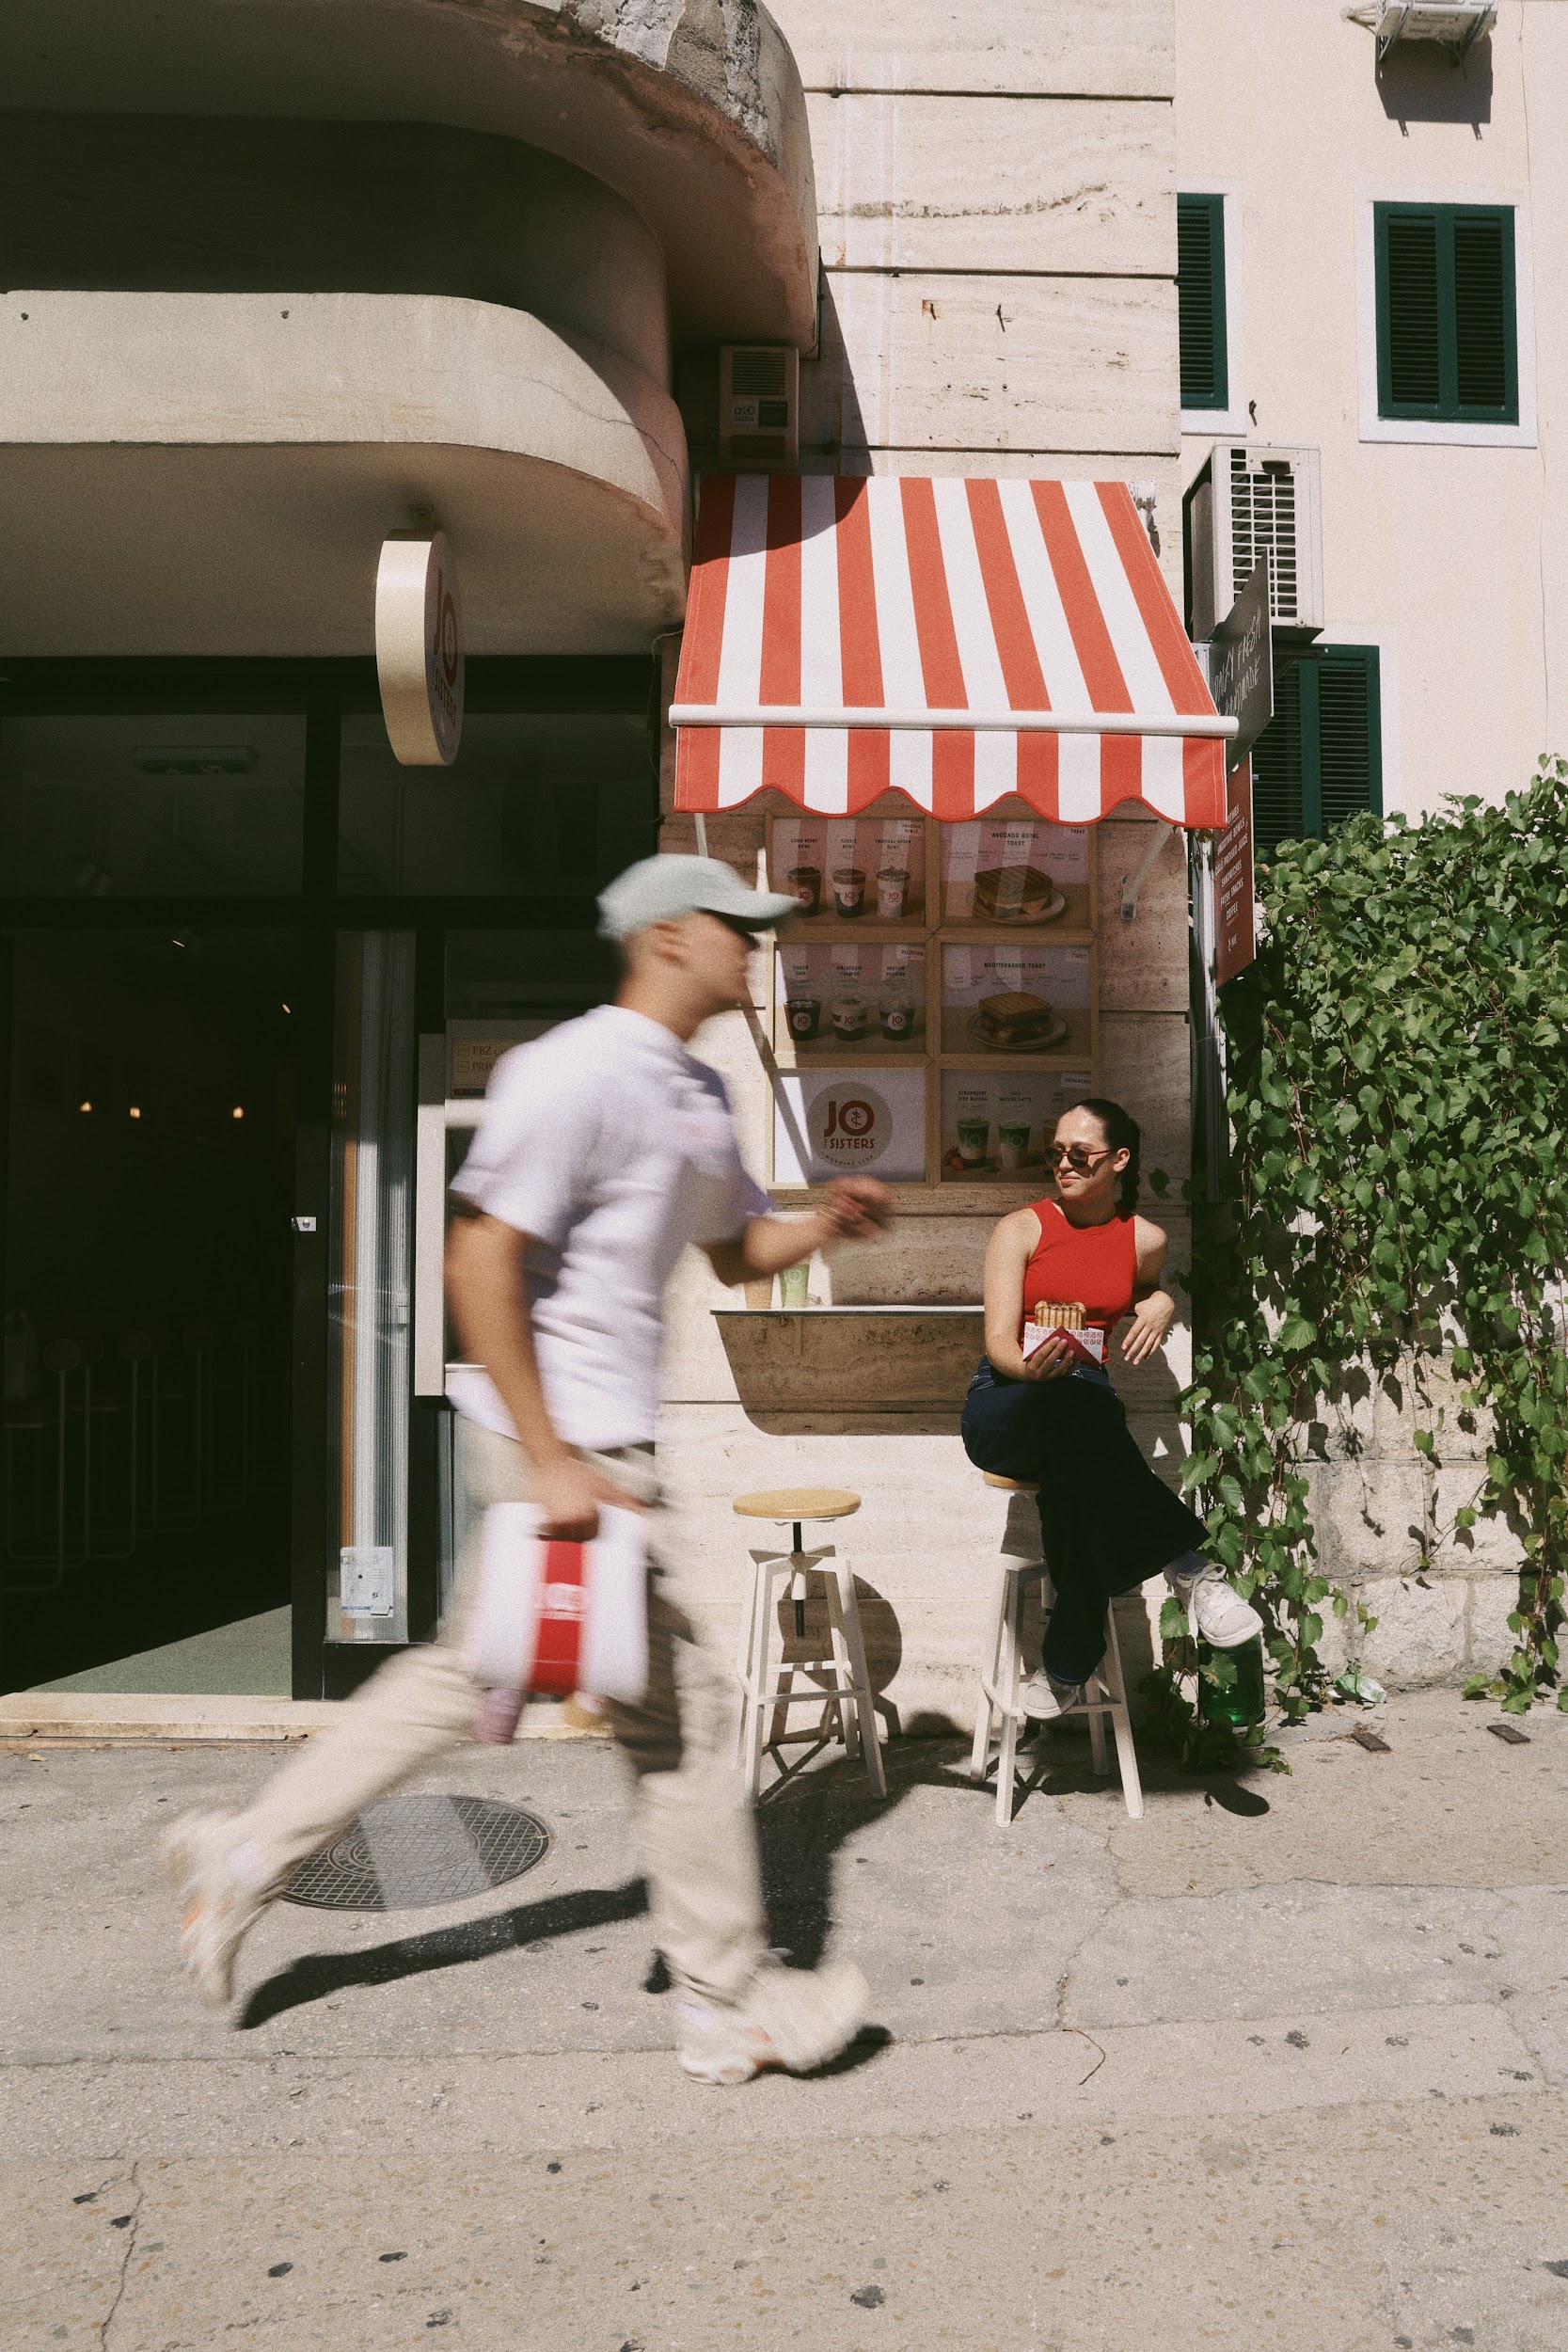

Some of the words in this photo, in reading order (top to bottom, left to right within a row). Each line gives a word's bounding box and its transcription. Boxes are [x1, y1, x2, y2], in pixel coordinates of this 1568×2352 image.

[433, 566, 458, 688] JO
[1233, 817, 1244, 837] BOWLS
[1224, 844, 1237, 866] PRESSED
[1238, 833, 1247, 851] JUICE
[1221, 860, 1242, 887] SANDWICHES
[1221, 890, 1231, 908] FRESH
[1231, 877, 1243, 898] SNACKS
[1227, 901, 1239, 920] COFFEE
[472, 1045, 492, 1056] PBZ
[824, 1100, 875, 1137] JO
[829, 1137, 875, 1149] SISTERS
